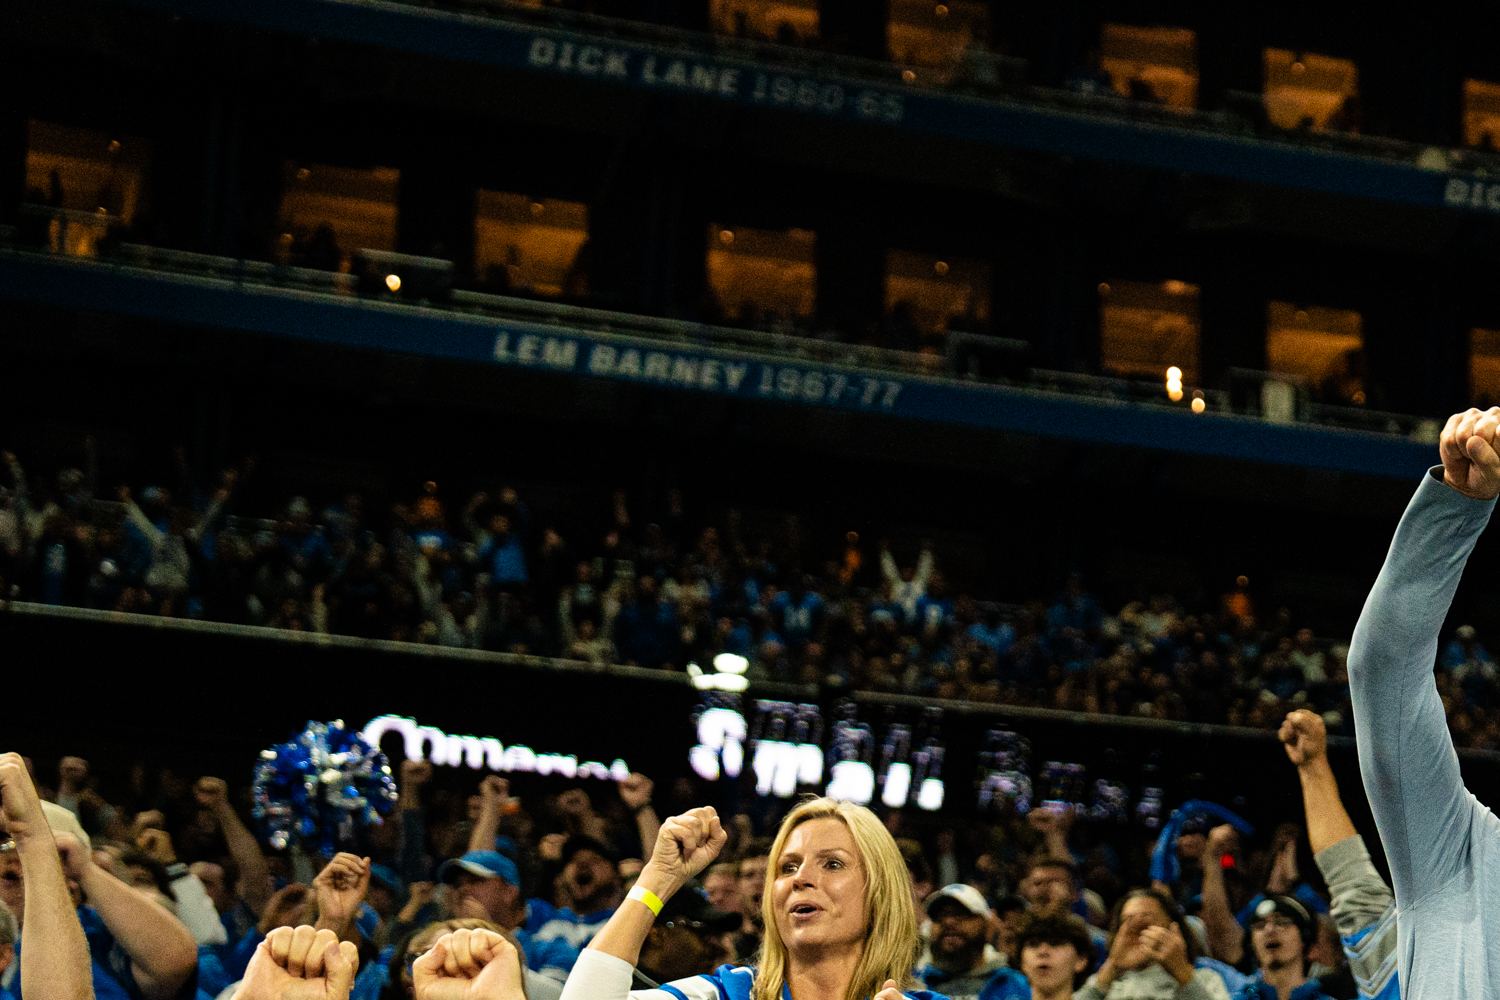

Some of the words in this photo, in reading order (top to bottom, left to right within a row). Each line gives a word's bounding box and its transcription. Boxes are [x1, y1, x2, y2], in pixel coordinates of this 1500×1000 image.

[528, 38, 630, 79] DICK
[642, 54, 741, 95] LANE
[492, 330, 580, 370] LEM
[588, 343, 748, 392] BARNEY
[757, 364, 904, 408] 1967-77
